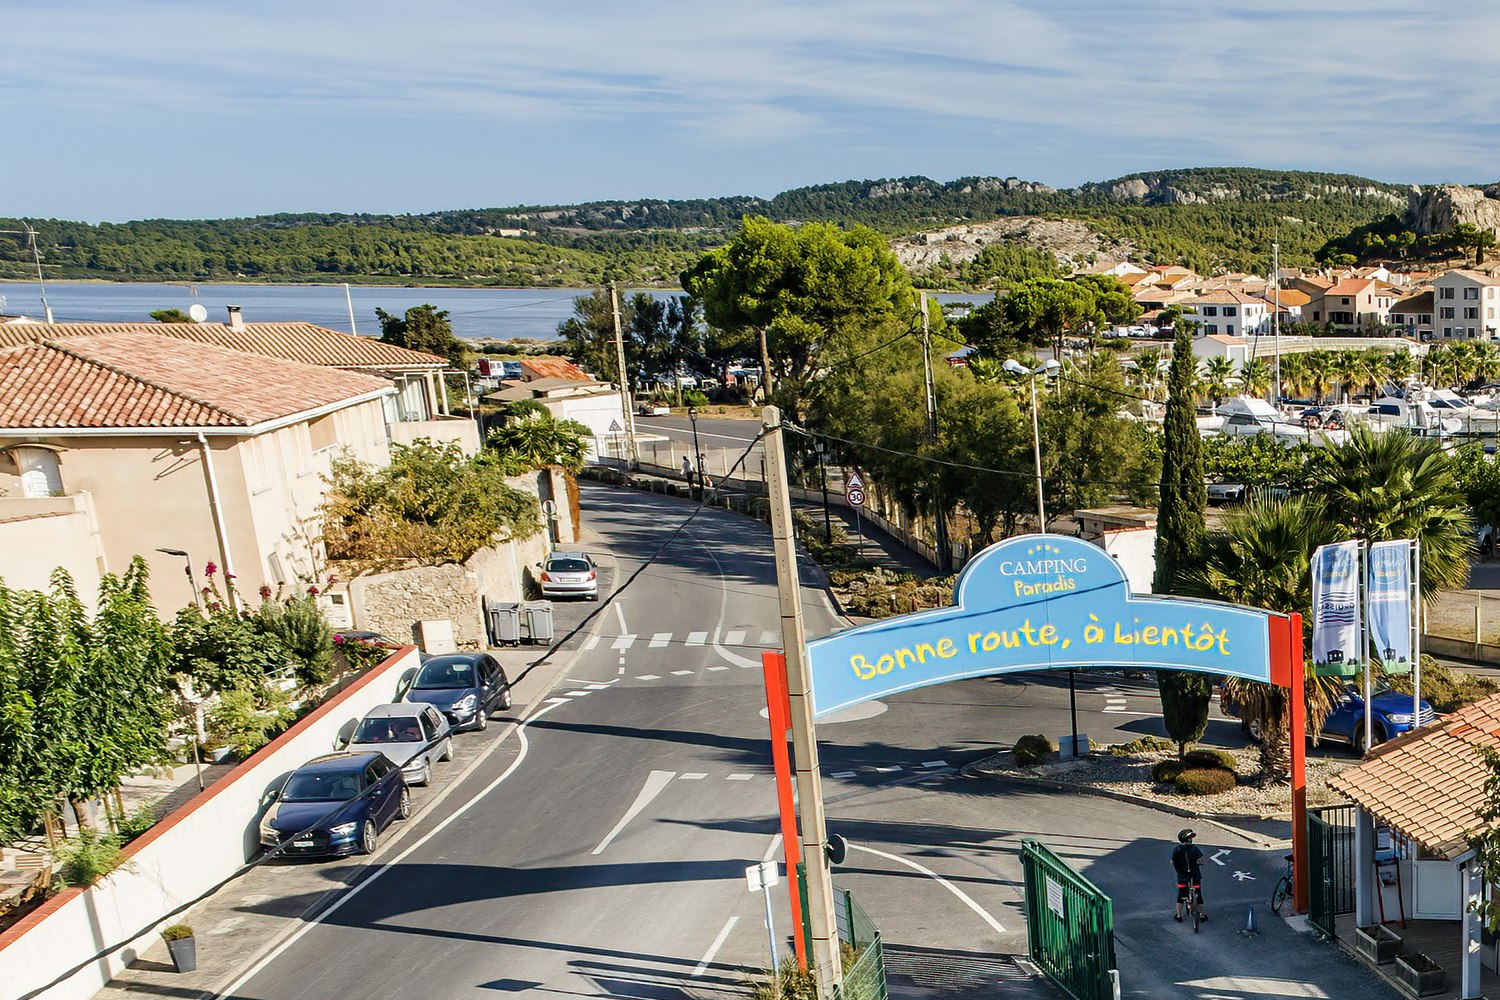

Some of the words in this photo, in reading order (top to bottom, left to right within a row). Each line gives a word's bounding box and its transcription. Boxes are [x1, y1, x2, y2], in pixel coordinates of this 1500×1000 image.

[851, 493, 862, 501] 30
[1000, 558, 1087, 576] CAMPING
[1014, 574, 1076, 597] Paradis
[850, 638, 958, 680] Bonne
[967, 618, 1071, 653] route,
[1084, 613, 1106, 645] à
[1114, 617, 1231, 656] bientôt
